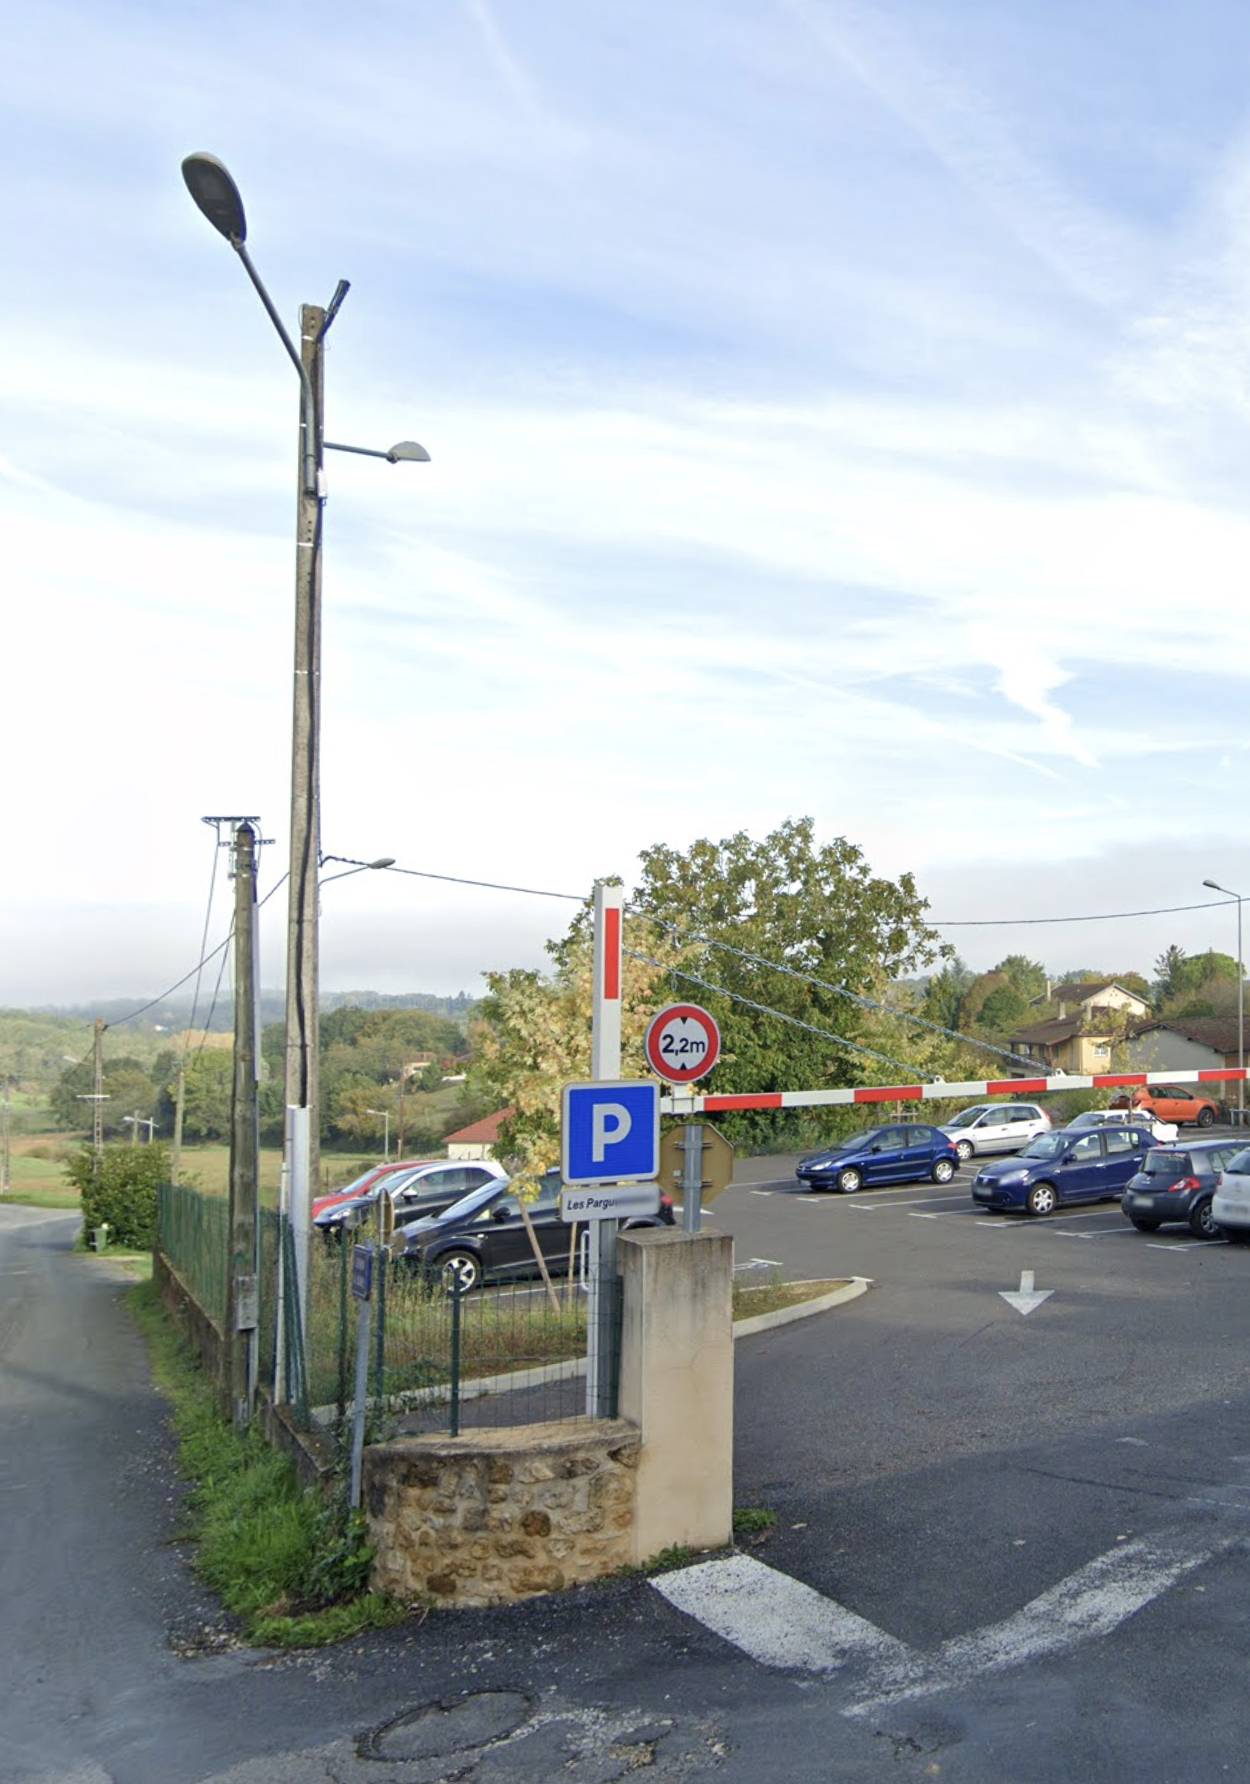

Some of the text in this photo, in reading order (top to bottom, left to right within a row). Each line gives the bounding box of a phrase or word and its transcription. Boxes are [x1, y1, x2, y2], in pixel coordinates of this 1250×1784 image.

[662, 1034, 706, 1056] 2,2m
[592, 1103, 632, 1162] P
[567, 1199, 585, 1211] Les
